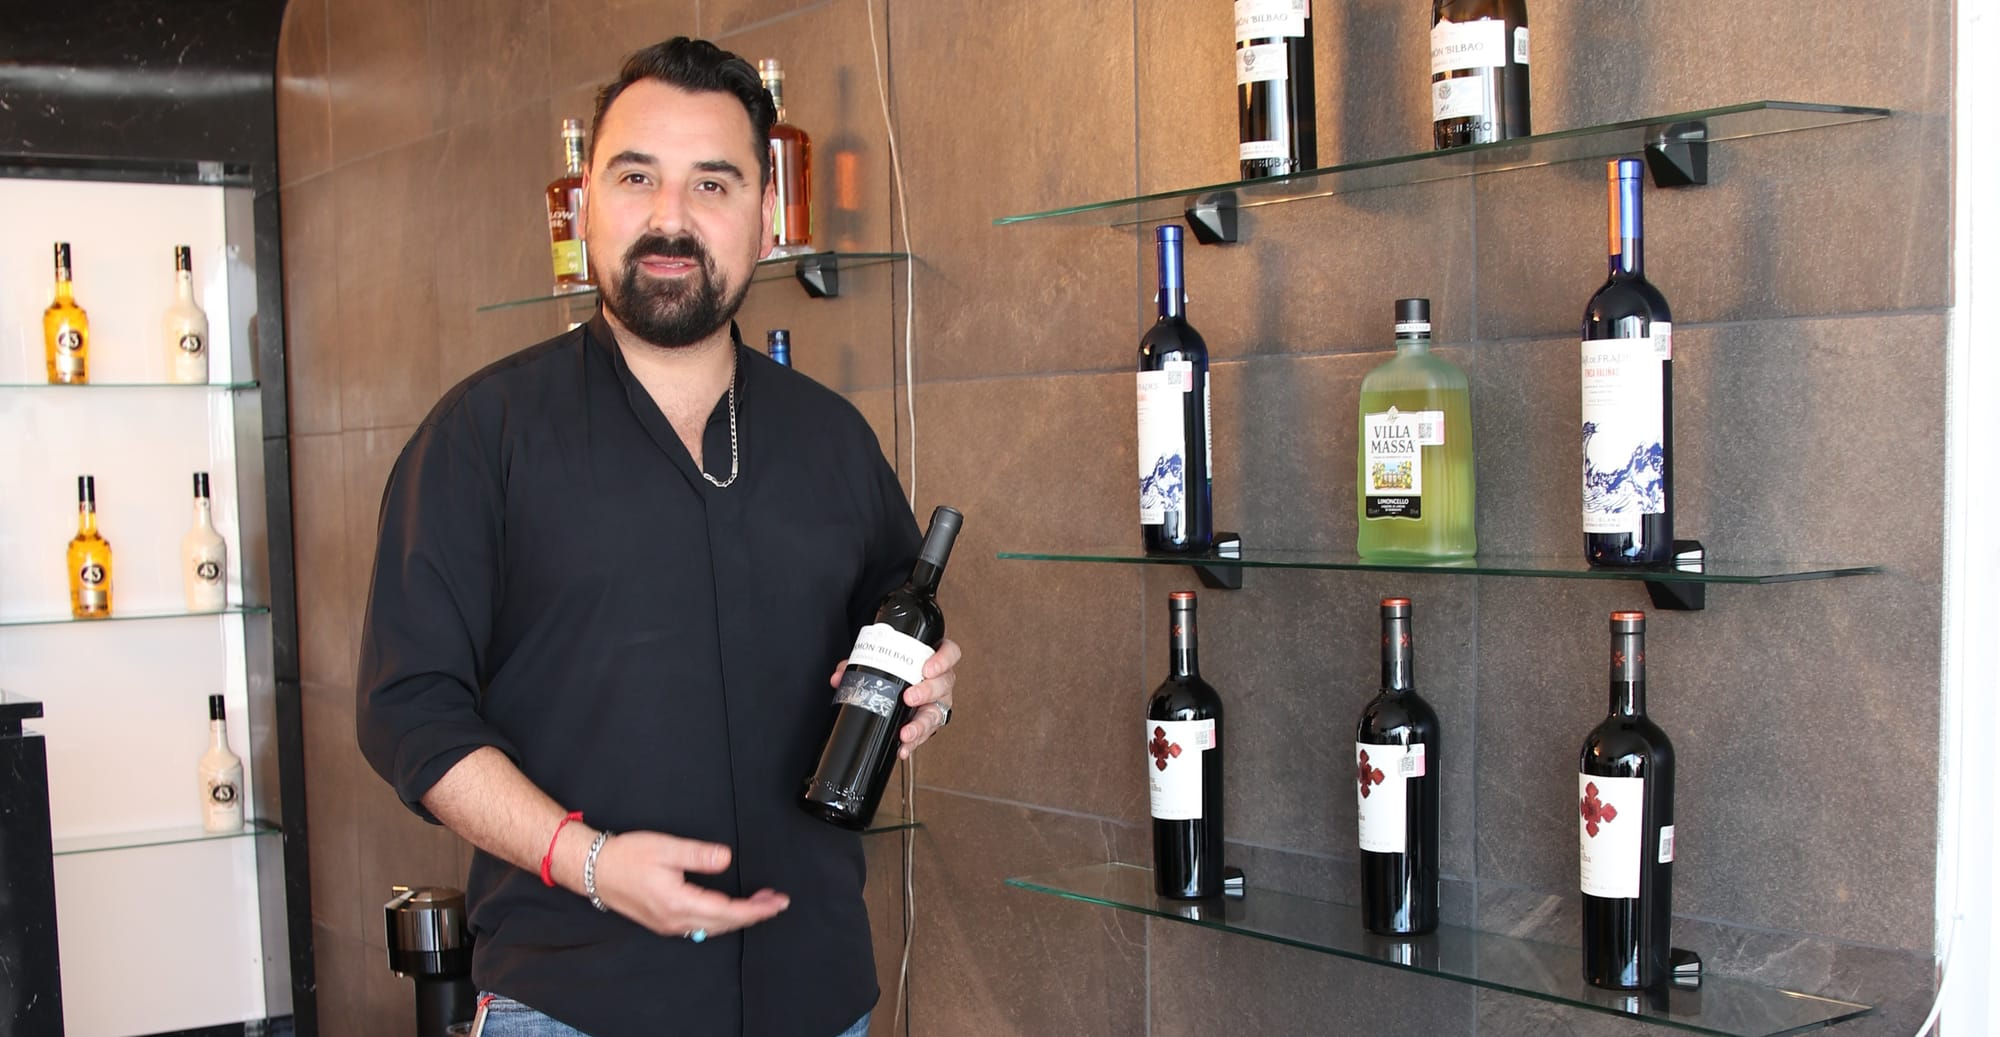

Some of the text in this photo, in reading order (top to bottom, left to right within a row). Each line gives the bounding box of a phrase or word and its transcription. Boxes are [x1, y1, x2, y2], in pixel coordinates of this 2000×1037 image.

[1250, 13, 1288, 23] BILBAO
[1445, 42, 1484, 54] BILBAO
[1374, 425, 1411, 439] VILLA
[1371, 440, 1415, 453] MASSA
[83, 565, 104, 583] 43
[198, 562, 217, 579] 43
[878, 645, 914, 666] BILBAO
